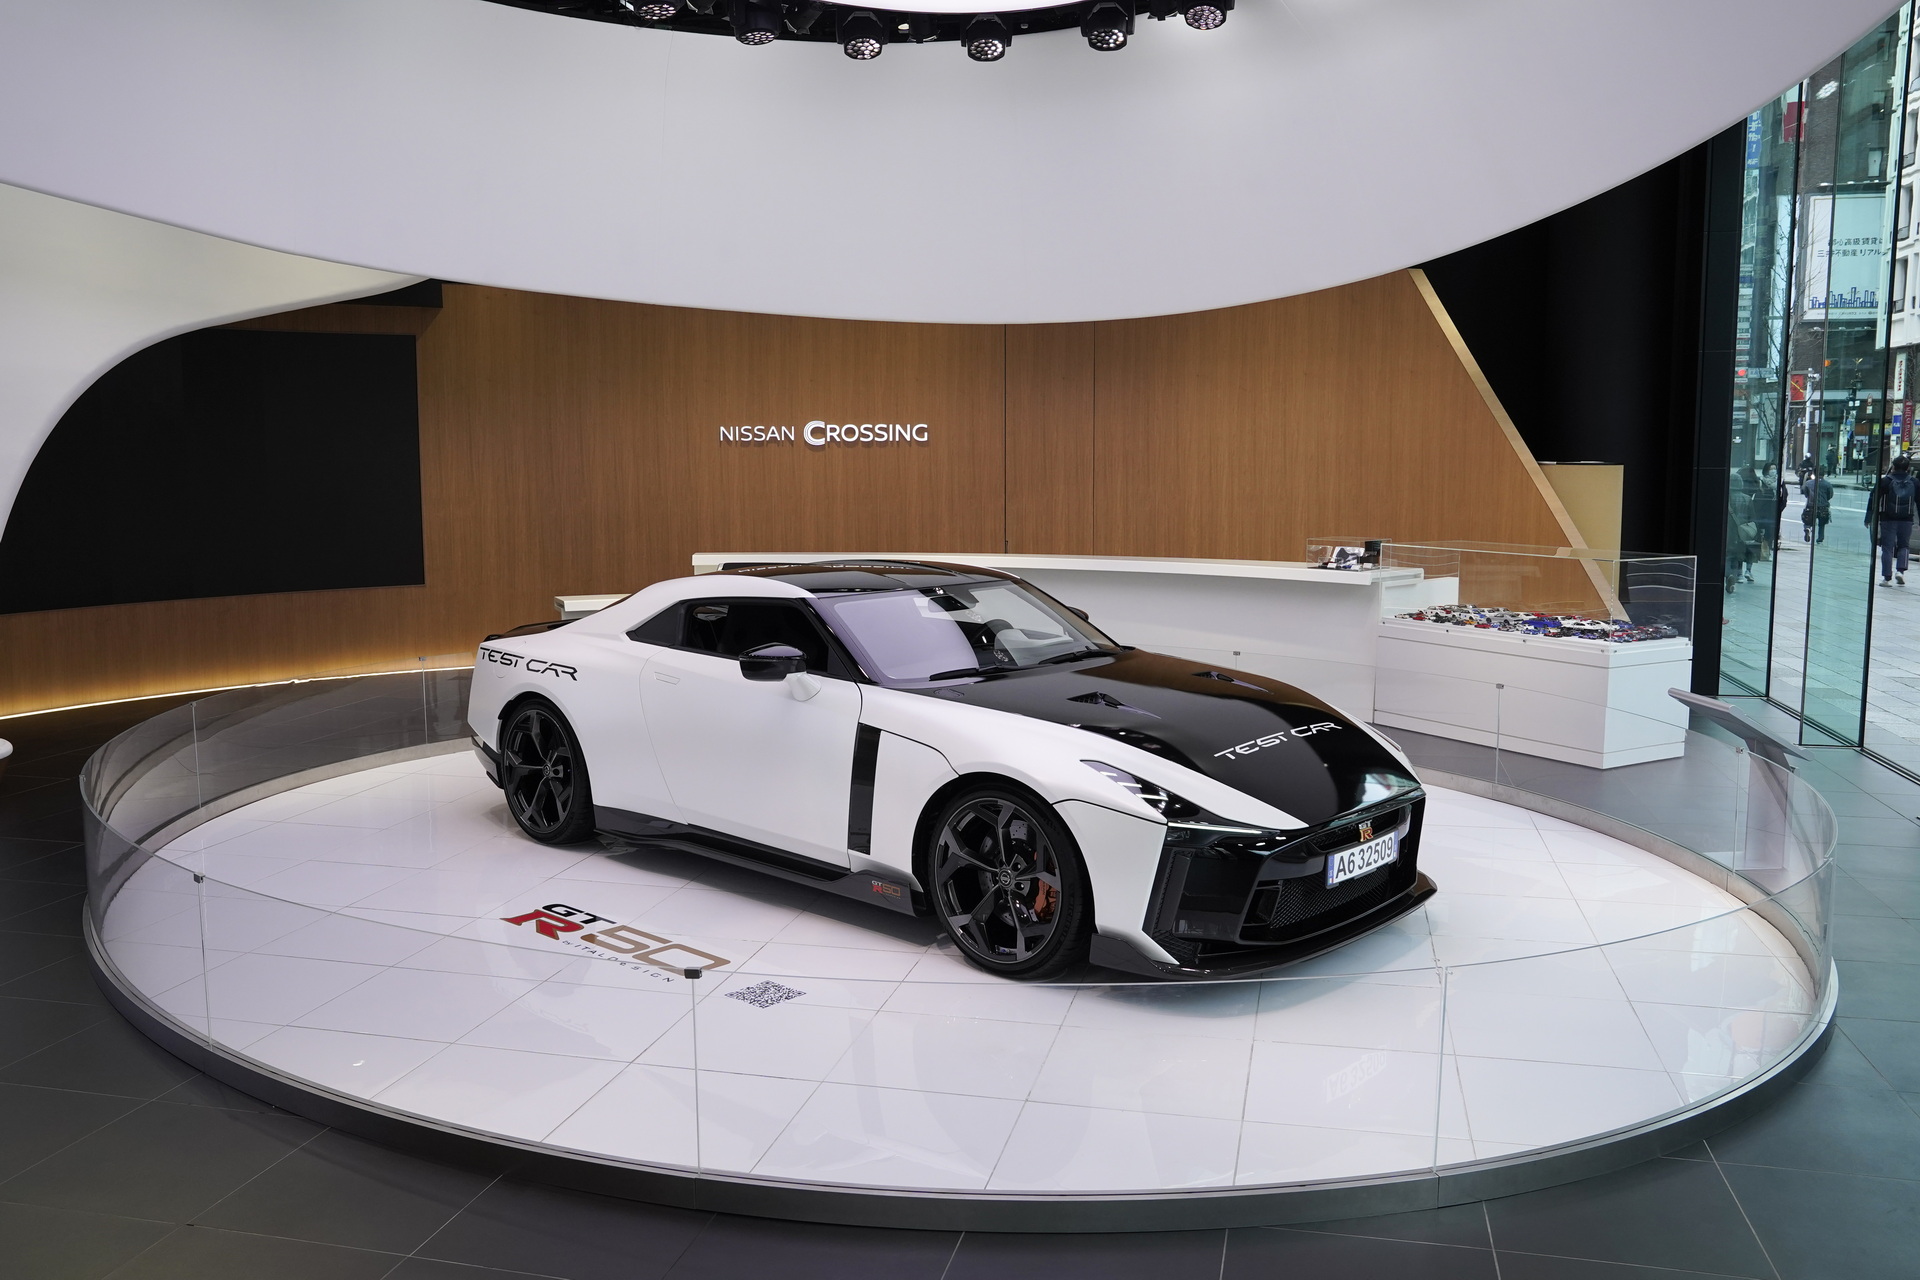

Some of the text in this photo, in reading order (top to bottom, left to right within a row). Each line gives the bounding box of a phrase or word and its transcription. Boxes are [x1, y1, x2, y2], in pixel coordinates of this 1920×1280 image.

[720, 420, 929, 446] NISSAN CROSSING
[480, 646, 578, 682] TEST CAR
[1213, 721, 1343, 760] TEST CAR
[1358, 819, 1373, 829] GT
[1359, 827, 1374, 843] R
[1335, 851, 1355, 879] A6
[1358, 836, 1394, 870] 32509
[542, 903, 618, 925] GT
